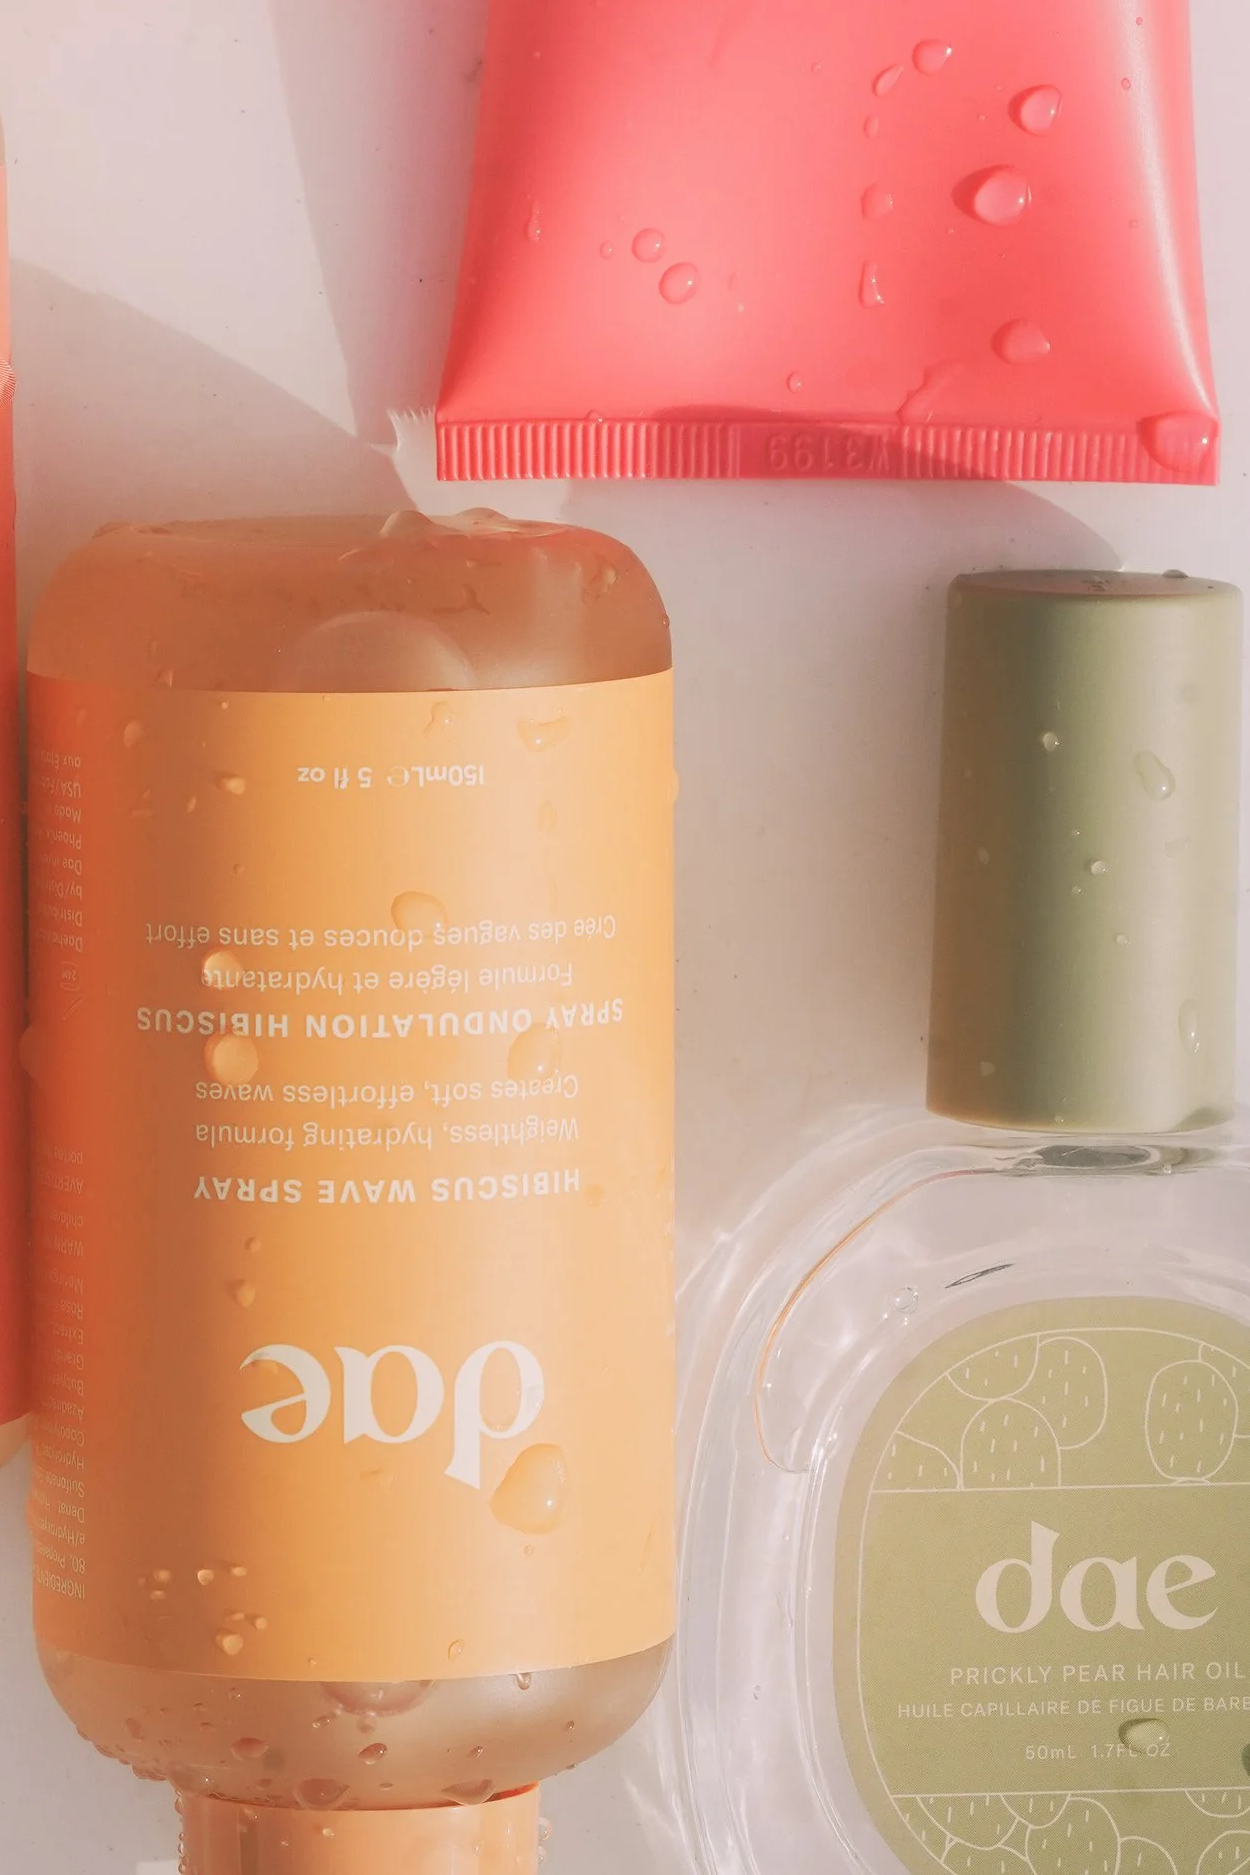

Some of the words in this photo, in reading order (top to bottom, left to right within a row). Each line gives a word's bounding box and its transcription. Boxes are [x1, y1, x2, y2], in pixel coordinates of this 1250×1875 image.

[297, 766, 325, 783] oz
[334, 766, 349, 789] fl
[357, 766, 373, 789] 5
[411, 762, 485, 789] 150mL
[145, 923, 210, 949] effort
[219, 925, 280, 946] sans
[289, 927, 315, 951] et
[324, 926, 423, 952] douces
[433, 919, 520, 947] vagues
[528, 919, 567, 944] des
[573, 913, 616, 941] Crée
[201, 966, 343, 996] hydratante
[353, 970, 379, 995] et
[388, 964, 469, 995] légère
[479, 963, 572, 992] Formule
[137, 1006, 288, 1037] HIBISCUS
[306, 1009, 531, 1039] ONDULATION
[545, 997, 623, 1030] SPRAY
[195, 1081, 274, 1103] waves
[282, 1081, 414, 1110] effortless
[424, 1080, 482, 1109] soft,
[491, 1074, 579, 1100] Creates
[195, 1124, 294, 1151] formula
[302, 1121, 432, 1152] hydrating
[442, 1115, 579, 1147] Weightless,
[193, 1175, 302, 1204] SPRAY
[318, 1178, 416, 1204] WAVE
[432, 1168, 580, 1204] HIBISCUS
[239, 1340, 545, 1490] dae
[975, 1520, 1219, 1634] dae
[950, 1666, 1052, 1687] PRICKLY
[1062, 1664, 1126, 1683] PEAR
[1136, 1662, 1196, 1682] HAIR
[1206, 1661, 1246, 1679] OIL
[898, 1702, 953, 1718] HUILE
[961, 1699, 1070, 1717] CAPILLAIRE
[1078, 1699, 1101, 1714] DE
[1110, 1698, 1165, 1714] FIGUE
[1173, 1697, 1196, 1712] DE
